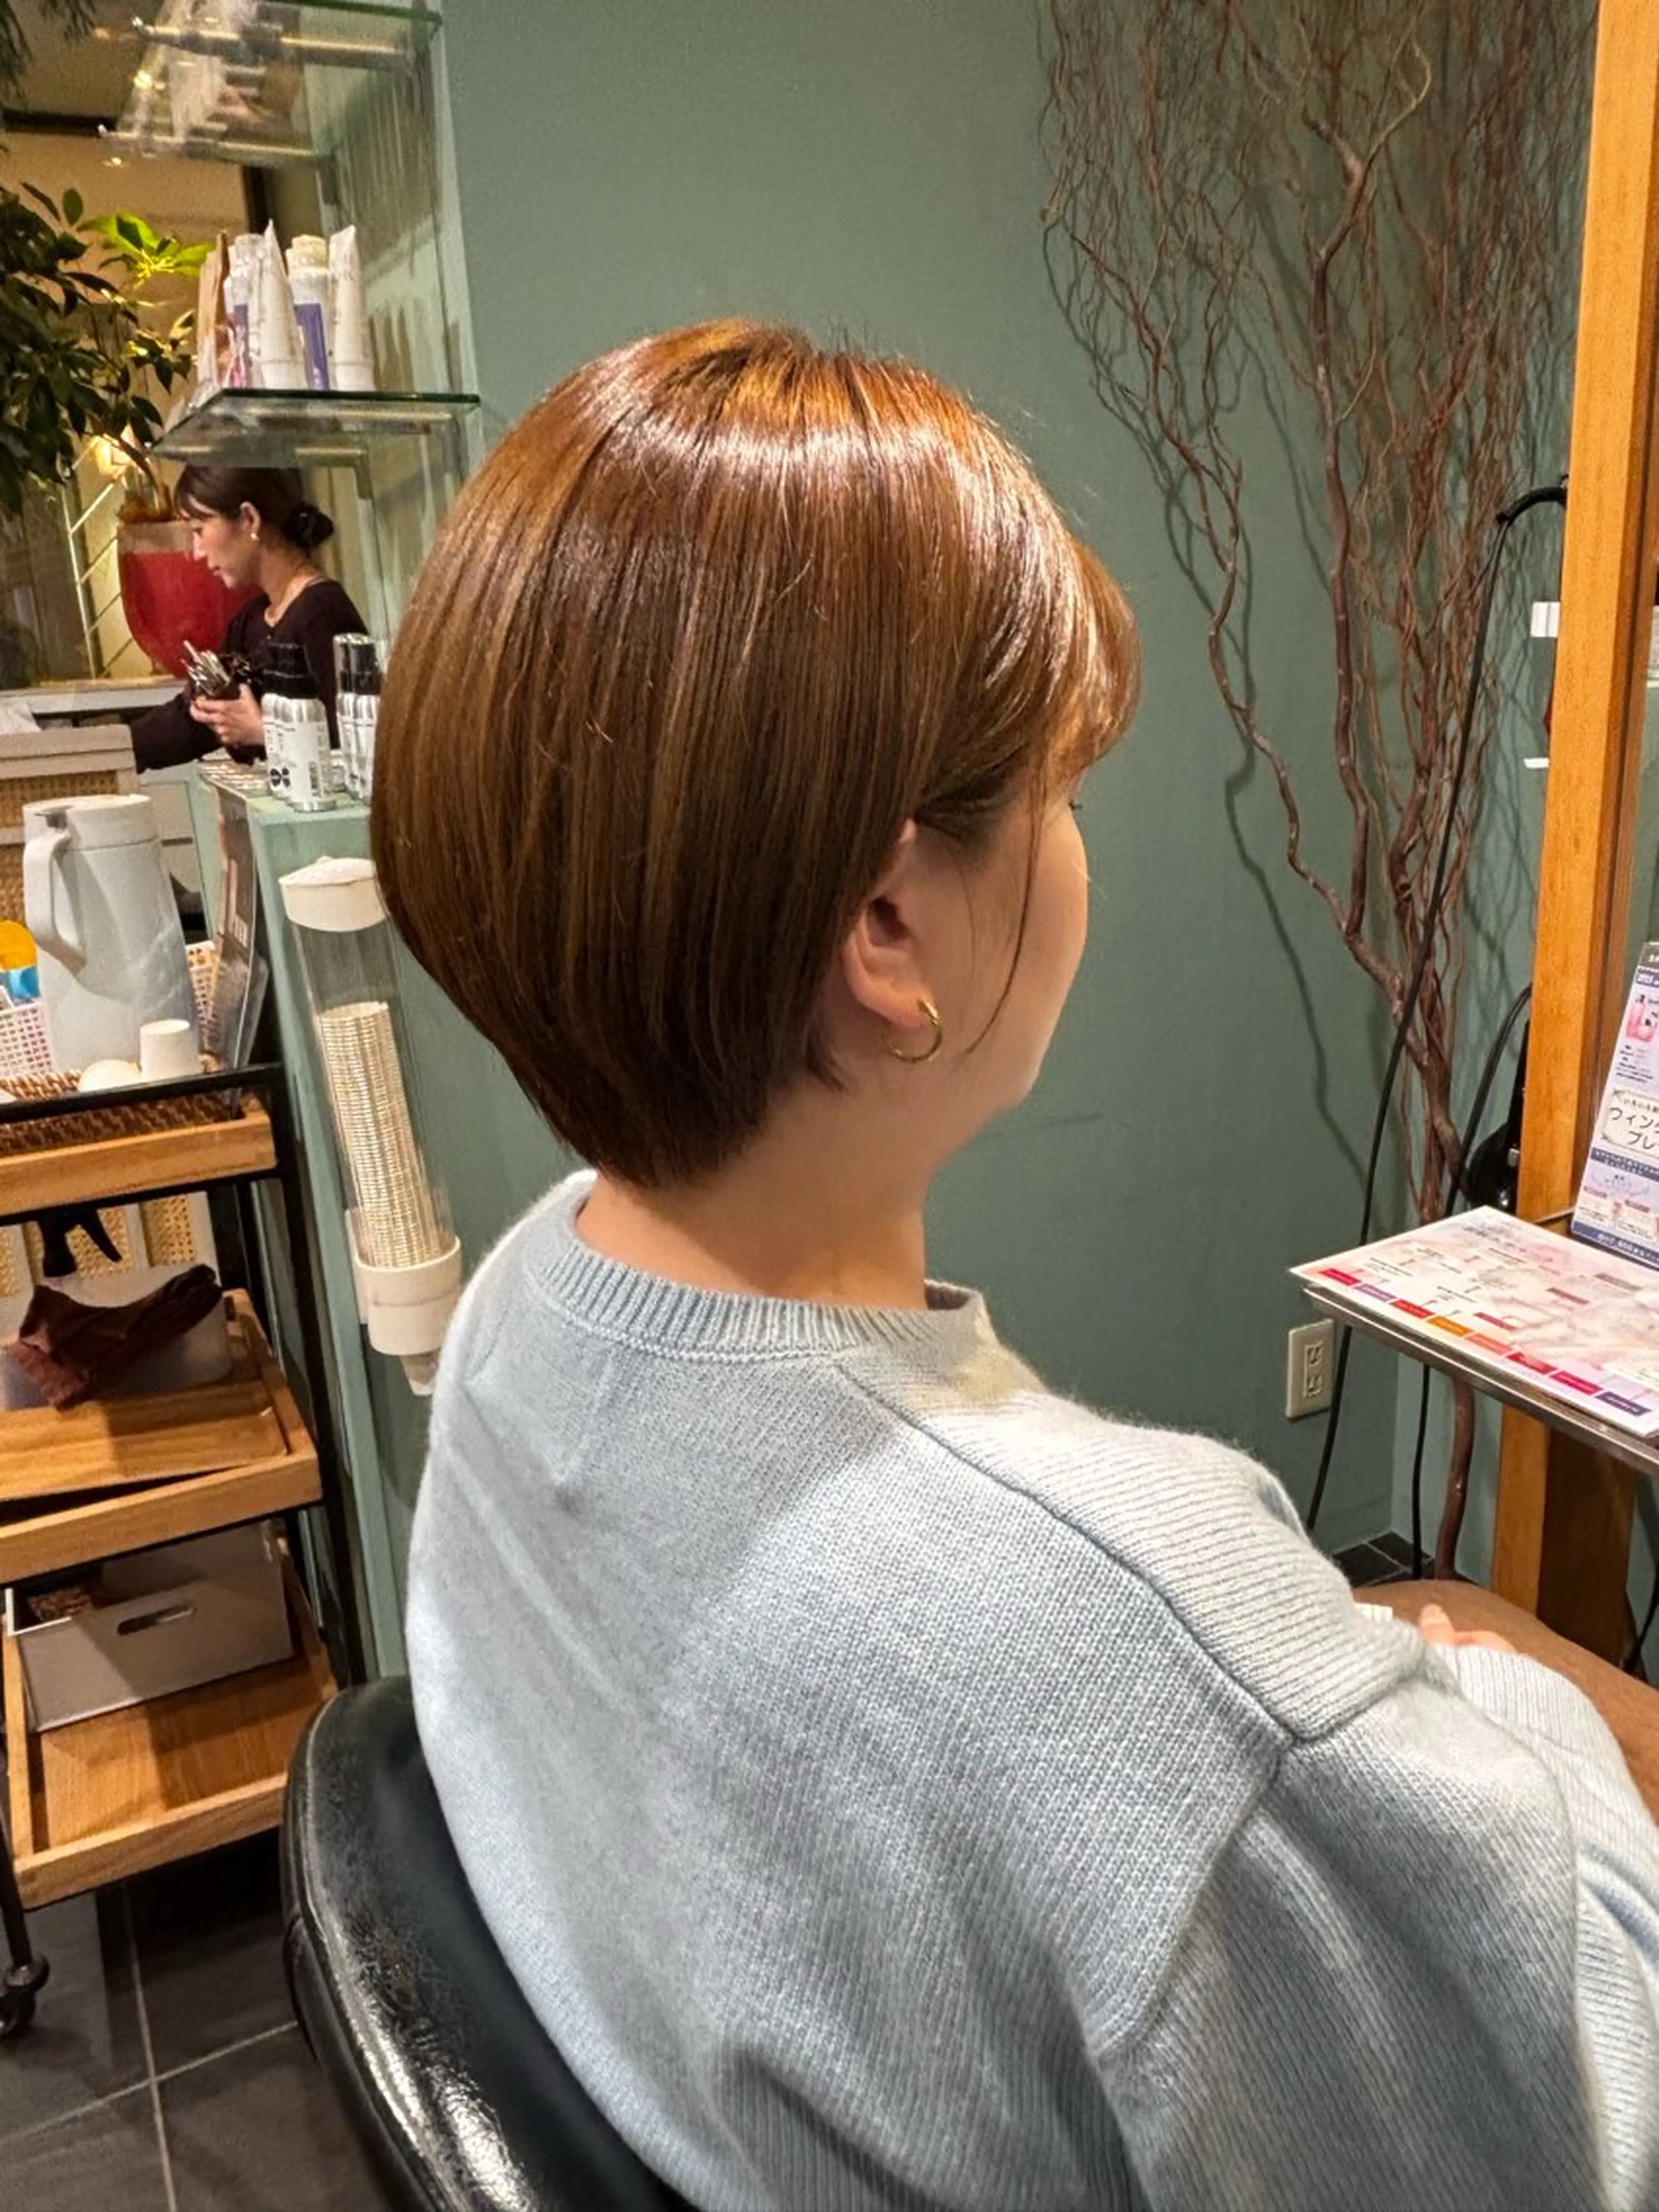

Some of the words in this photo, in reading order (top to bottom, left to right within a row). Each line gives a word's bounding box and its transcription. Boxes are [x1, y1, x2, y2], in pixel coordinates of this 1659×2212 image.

[1610, 1107, 1659, 1134] ウィン
[1627, 1130, 1659, 1150] プレ
